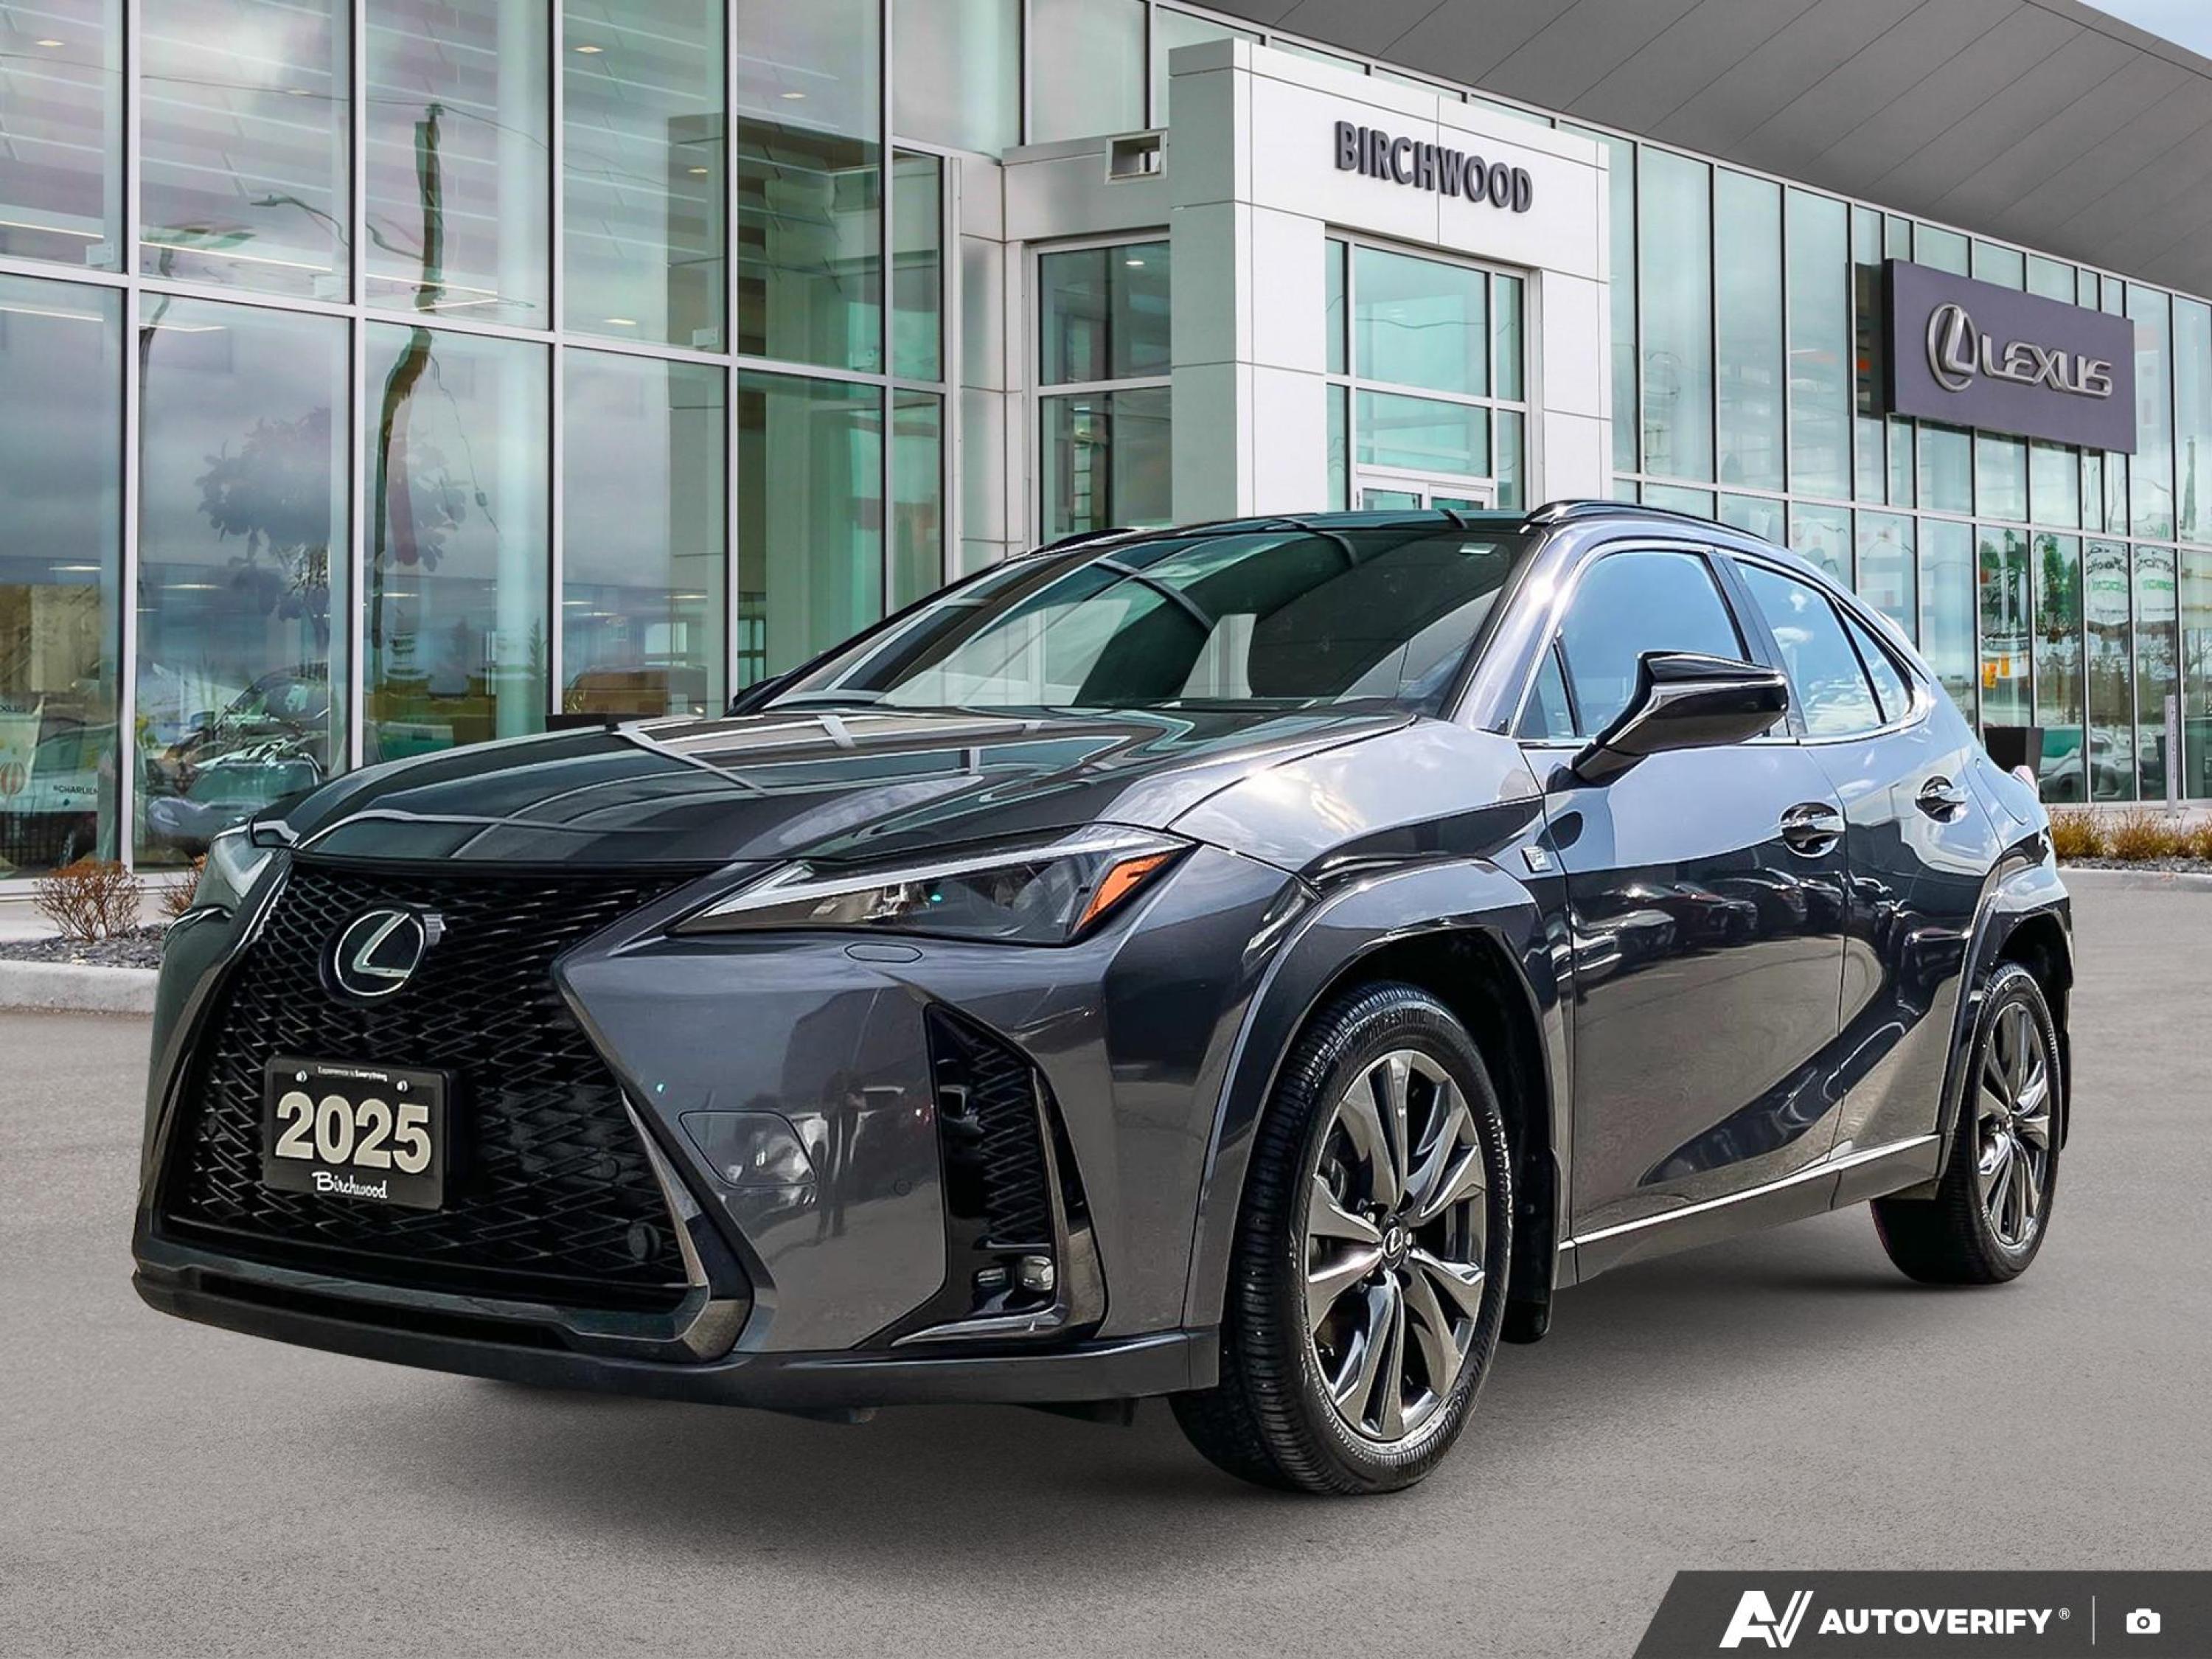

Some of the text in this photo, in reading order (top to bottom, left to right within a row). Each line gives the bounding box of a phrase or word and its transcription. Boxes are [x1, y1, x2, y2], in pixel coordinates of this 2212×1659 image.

[1334, 120, 1533, 214] BIRCHWOOD
[1980, 333, 2113, 399] LEXUS
[275, 1091, 432, 1174] 2025
[310, 1170, 388, 1200] Birchwood
